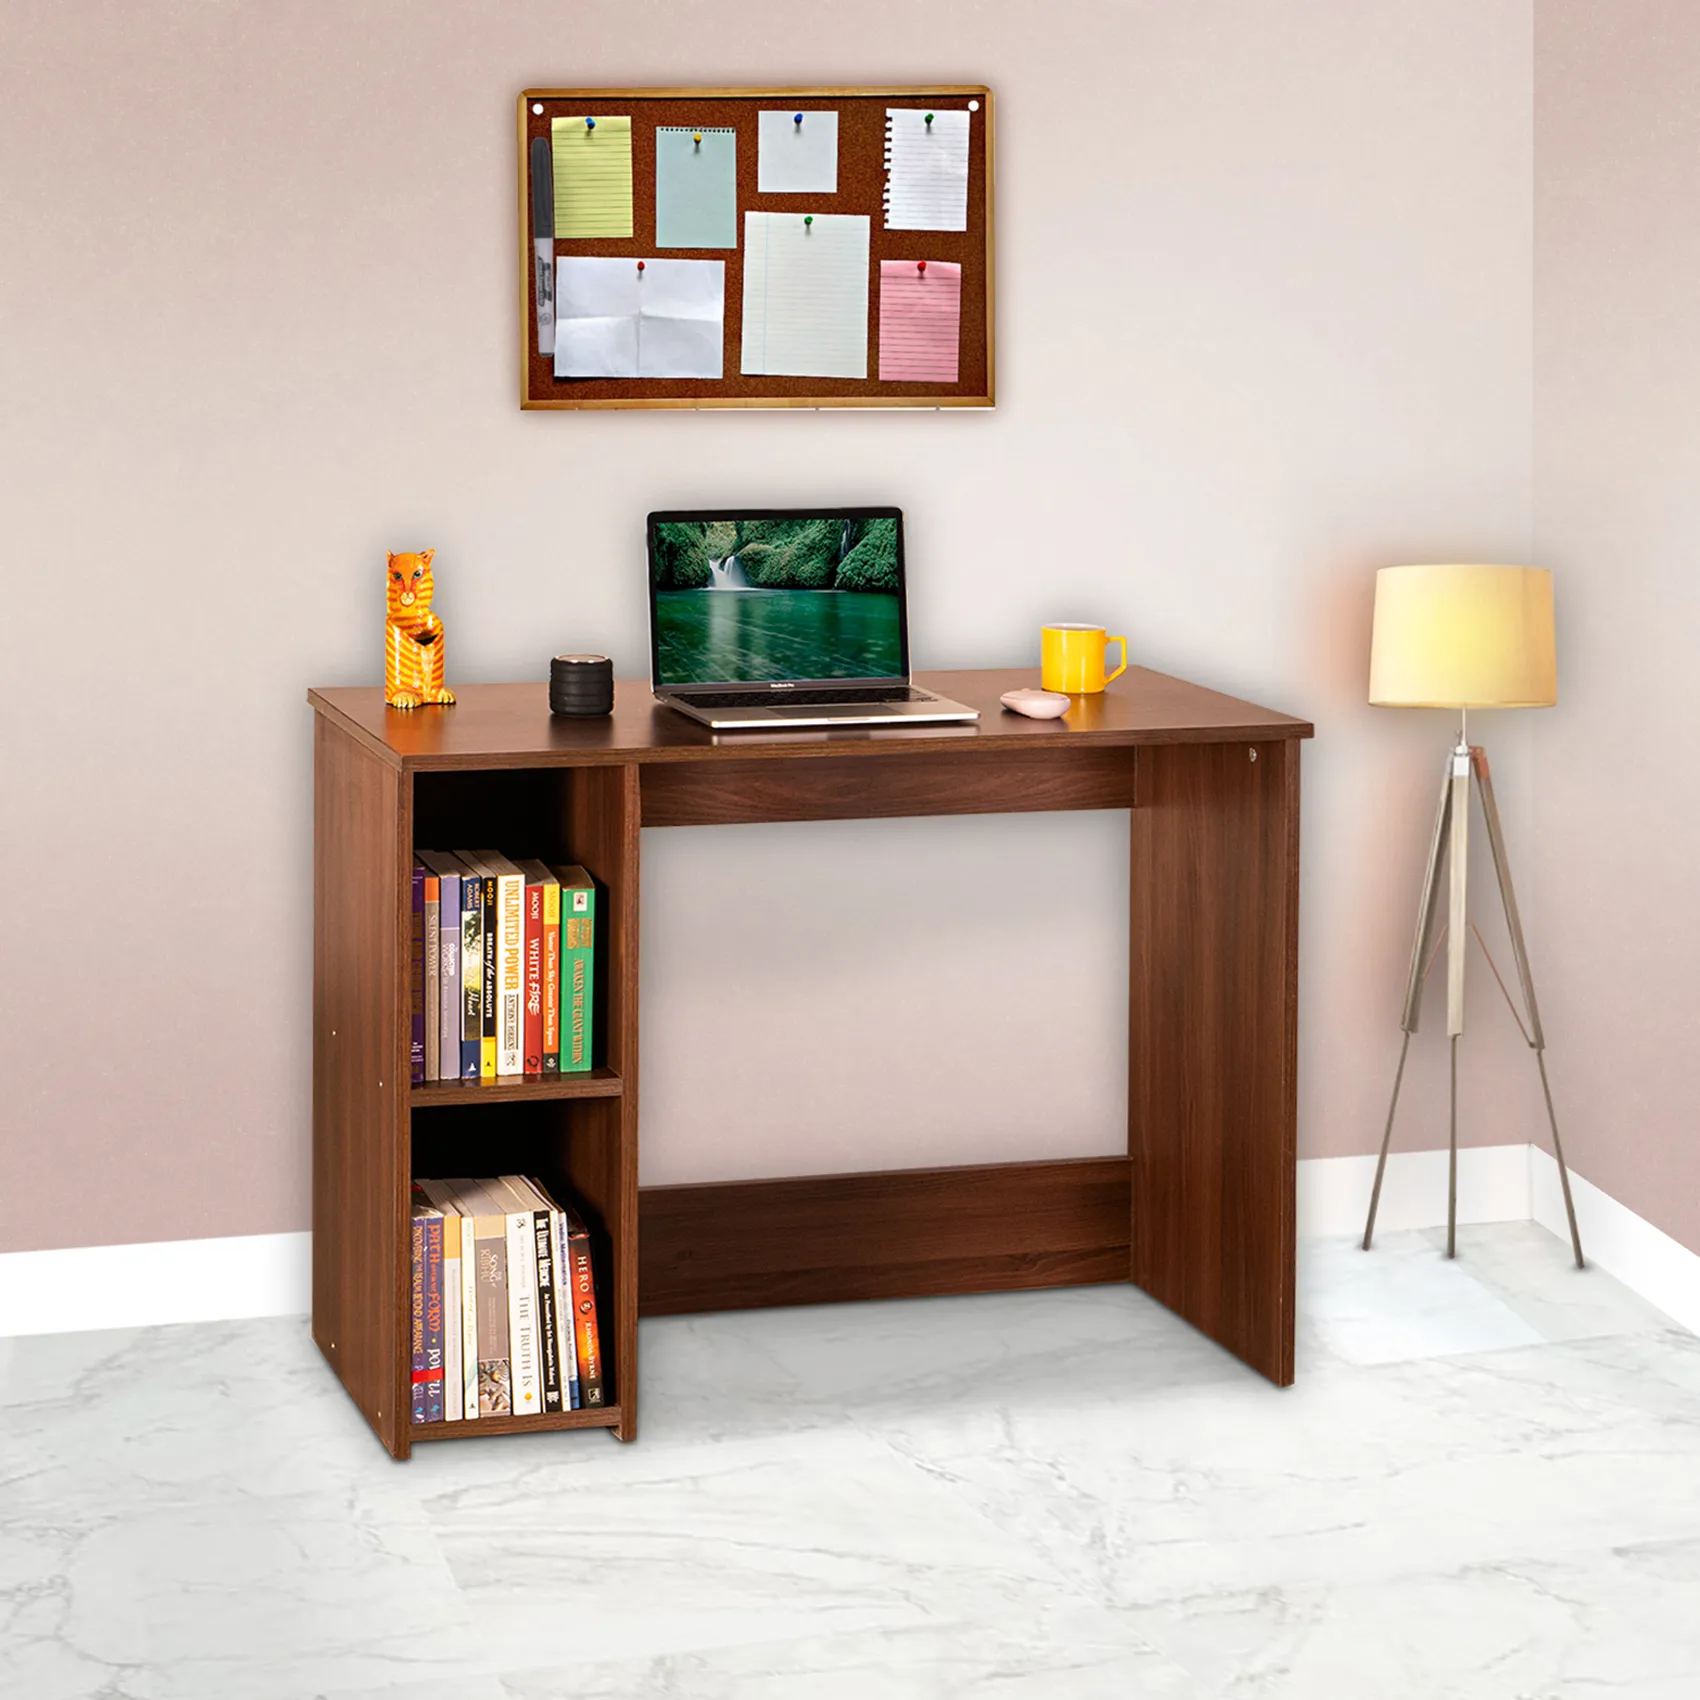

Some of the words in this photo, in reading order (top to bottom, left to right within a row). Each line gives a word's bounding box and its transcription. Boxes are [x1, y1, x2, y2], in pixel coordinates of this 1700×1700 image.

[466, 884, 474, 910] ADAMS
[486, 880, 494, 906] MOOJI
[530, 891, 540, 919] MOOJI
[504, 880, 520, 946] UNLIMITED
[428, 915, 438, 942] SILENT
[428, 944, 438, 976] POWER
[504, 948, 520, 990] POWER
[529, 938, 540, 980] WHITE
[548, 951, 556, 969] Than
[546, 970, 556, 982] Sky
[574, 958, 584, 992] AWAKEN
[527, 982, 541, 1016] FIRE
[548, 984, 556, 1008] Greater
[573, 993, 584, 1008] THE
[548, 1008, 556, 1026] Than
[572, 1009, 584, 1034] GIANT
[546, 1027, 555, 1046] Space
[572, 1034, 583, 1064] WITHIN
[536, 1218, 549, 1230] THE
[428, 1224, 440, 1263] PATH
[536, 1230, 549, 1258] ULTIMATE
[489, 1254, 498, 1282] SONG
[538, 1258, 551, 1288] MEDICINE
[560, 1243, 568, 1286] Mathematics
[578, 1256, 590, 1292] HERO
[427, 1292, 442, 1332] FORM
[520, 1295, 530, 1320] THE
[520, 1325, 532, 1370] TRUTH
[584, 1322, 594, 1354] RHONDA
[588, 1356, 596, 1380] BYRNE
